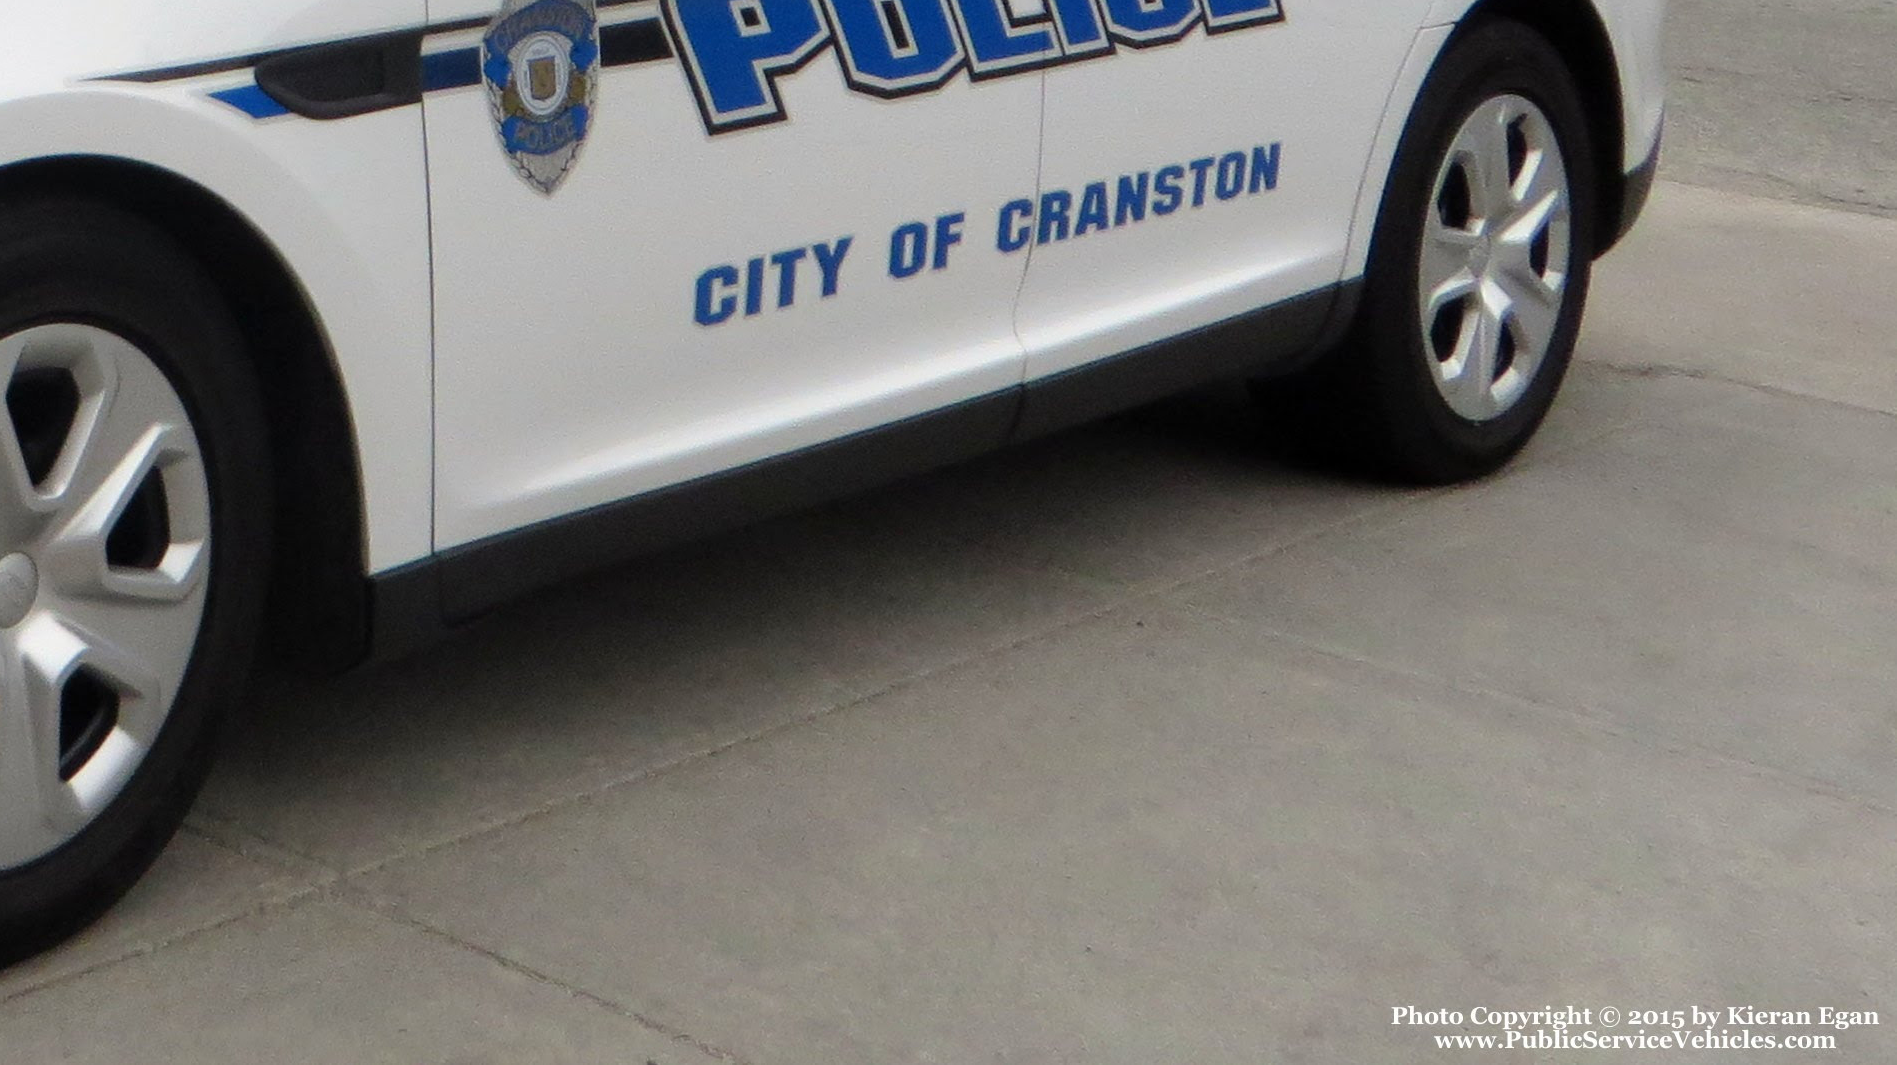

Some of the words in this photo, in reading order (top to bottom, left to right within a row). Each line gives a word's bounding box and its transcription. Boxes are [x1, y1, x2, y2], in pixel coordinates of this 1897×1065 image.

[693, 237, 853, 326] CITY
[887, 212, 966, 278] OF
[996, 142, 1283, 253] CRANSTON
